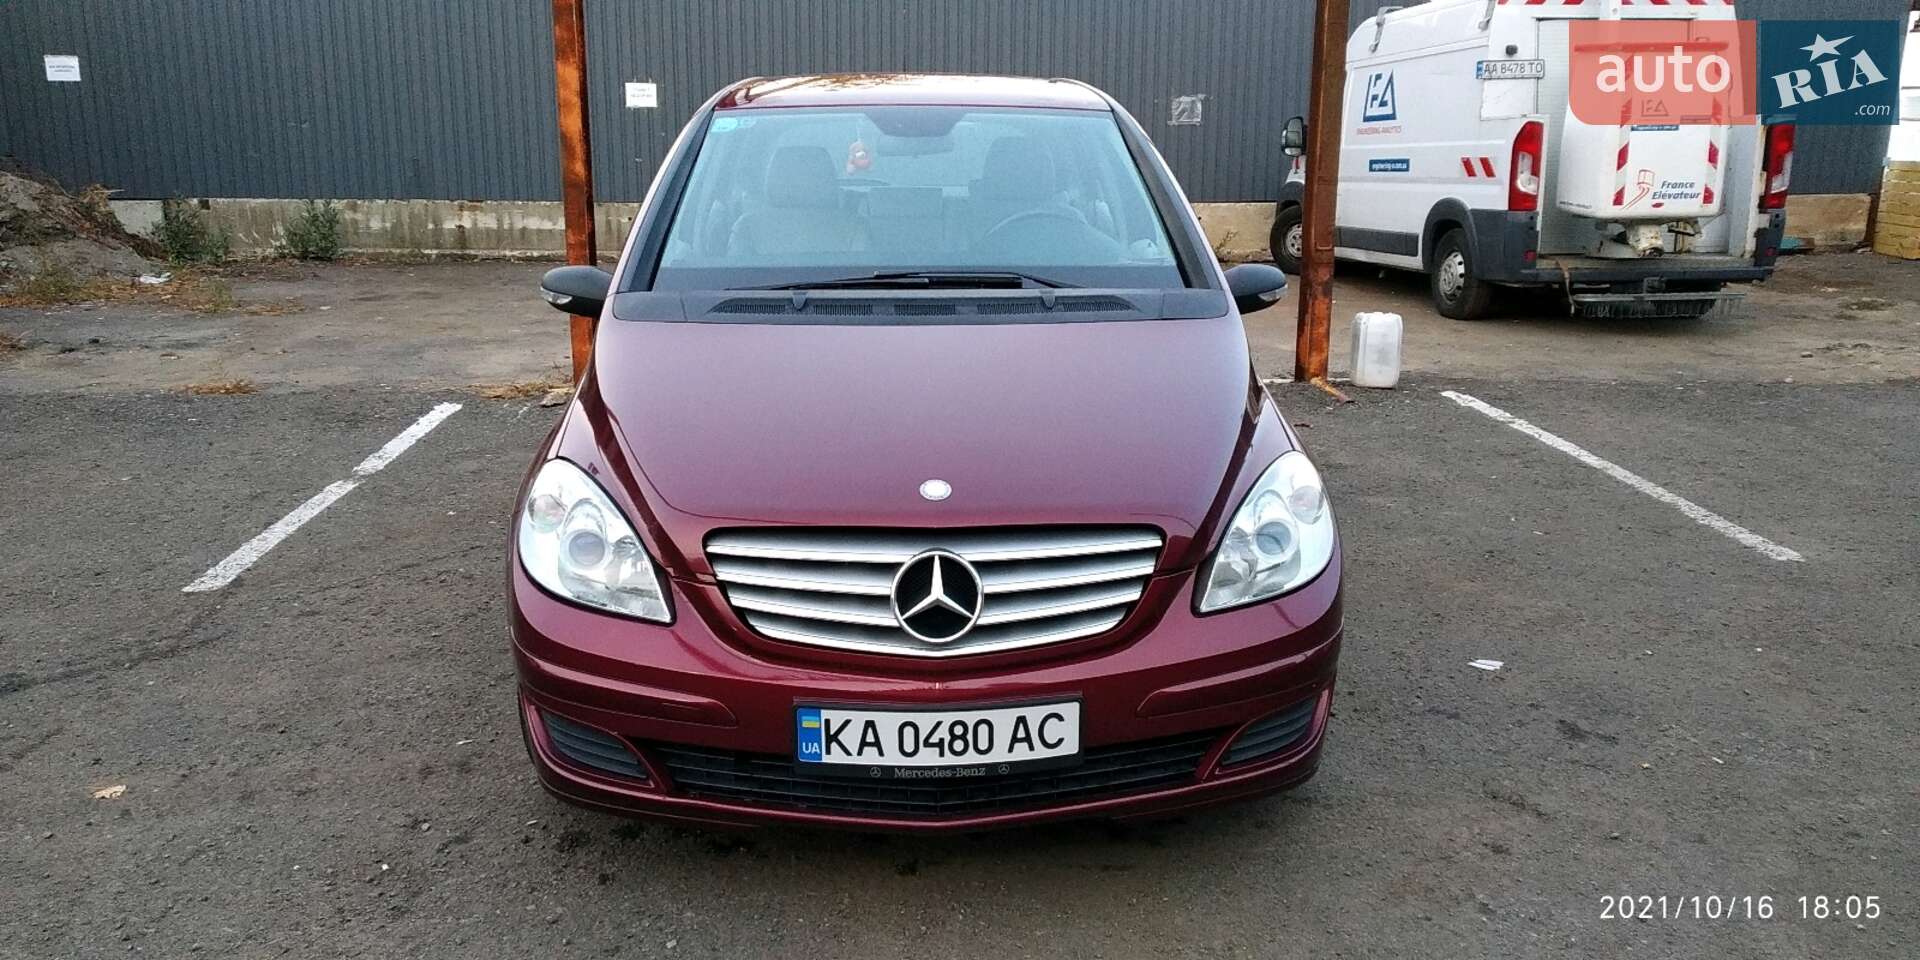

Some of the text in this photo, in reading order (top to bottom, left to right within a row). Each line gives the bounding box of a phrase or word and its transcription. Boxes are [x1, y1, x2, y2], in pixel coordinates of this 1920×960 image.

[1484, 63, 1497, 75] AA
[1500, 63, 1526, 74] 8478
[1661, 180, 1695, 189] France
[823, 712, 1065, 758] KA 0480 AC
[802, 742, 820, 755] UA
[894, 766, 986, 778] Mercedes-Benz
